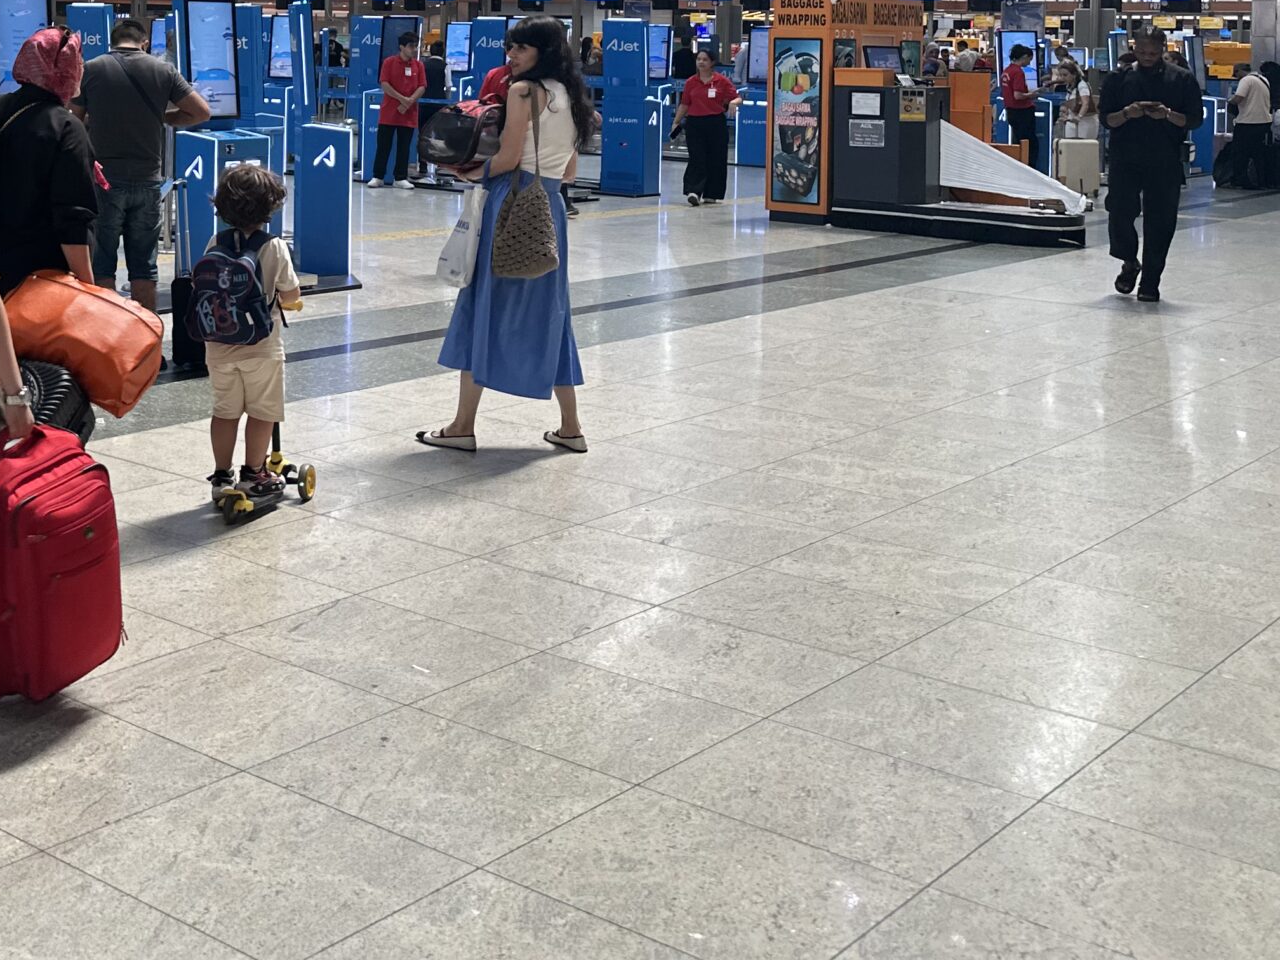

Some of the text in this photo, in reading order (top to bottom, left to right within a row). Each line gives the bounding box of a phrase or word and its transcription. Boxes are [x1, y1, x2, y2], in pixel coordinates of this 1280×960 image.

[778, 14, 826, 26] WRAPPING
[874, 3, 897, 26] BAGGAGE
[361, 33, 381, 46] AJe
[606, 38, 640, 52] AJet
